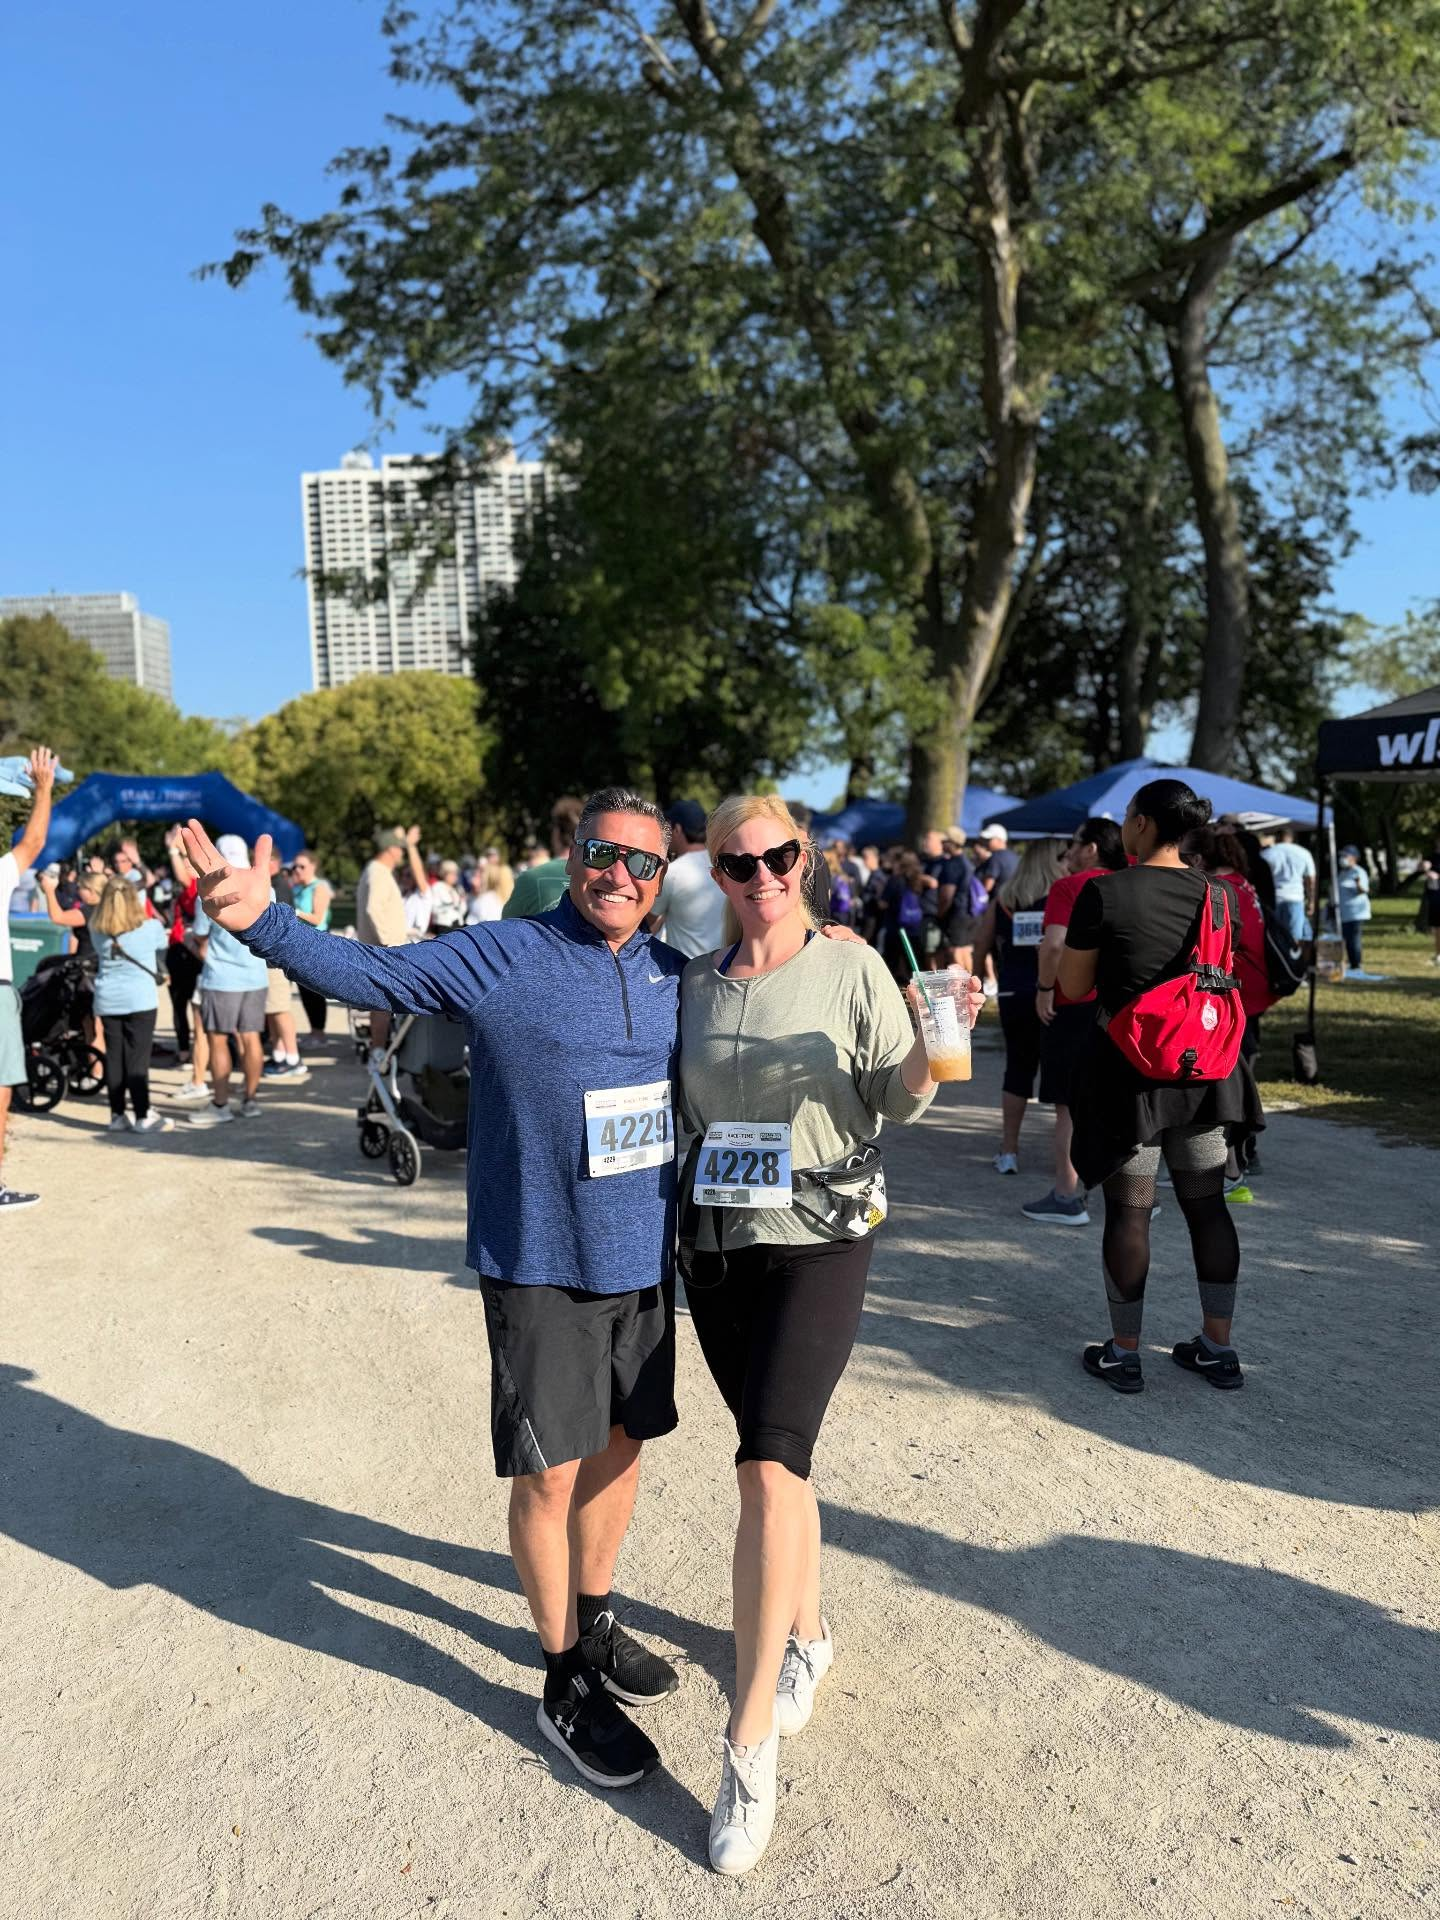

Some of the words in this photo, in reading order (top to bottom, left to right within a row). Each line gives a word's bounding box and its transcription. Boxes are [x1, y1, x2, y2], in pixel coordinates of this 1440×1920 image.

[1377, 717, 1440, 767] wl
[600, 1109, 668, 1152] 4229
[704, 1149, 780, 1186] 4228
